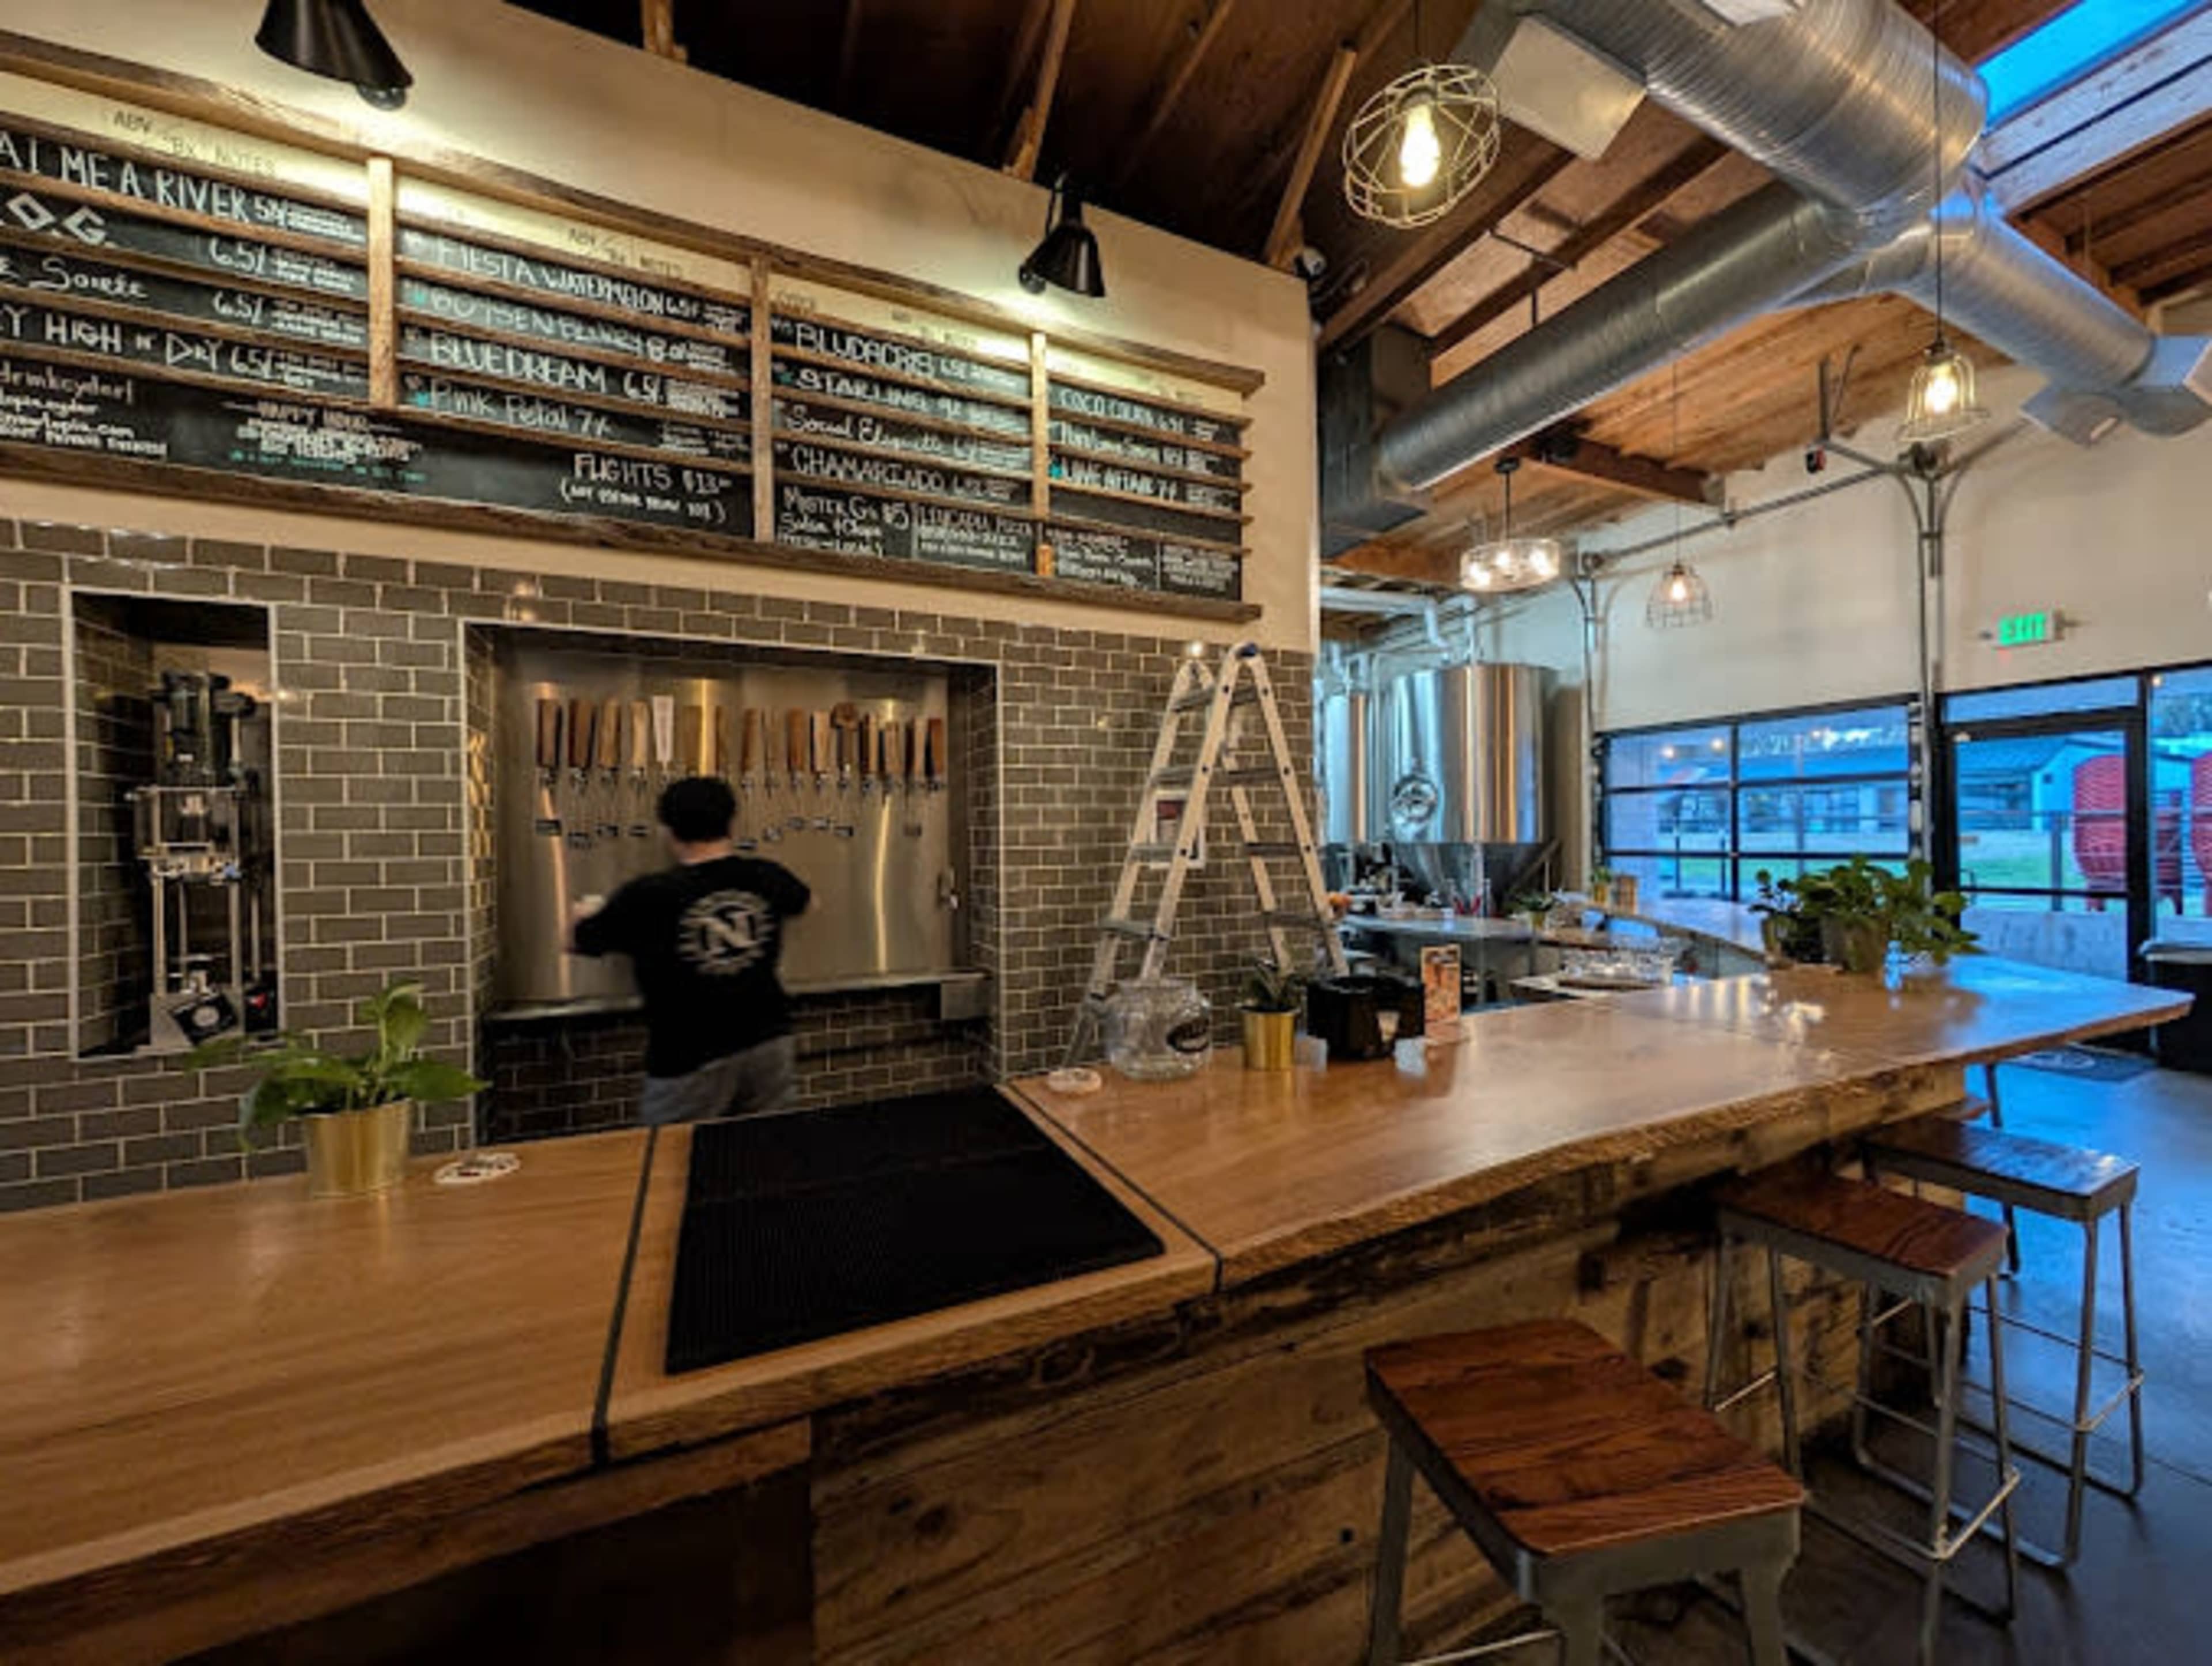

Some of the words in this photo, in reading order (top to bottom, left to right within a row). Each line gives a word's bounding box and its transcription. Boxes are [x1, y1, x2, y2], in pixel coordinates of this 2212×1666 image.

[60, 146, 109, 192] ME
[119, 161, 144, 198] A
[155, 169, 250, 225] RIVER
[44, 313, 123, 354] HIGH
[165, 332, 224, 371] DRY
[431, 333, 506, 374] BLUE
[506, 347, 606, 395] DREAM
[432, 378, 497, 416] Pink
[504, 393, 570, 432] Petal
[574, 453, 673, 491] FLIGHTS
[1998, 610, 2047, 647] EXIT
